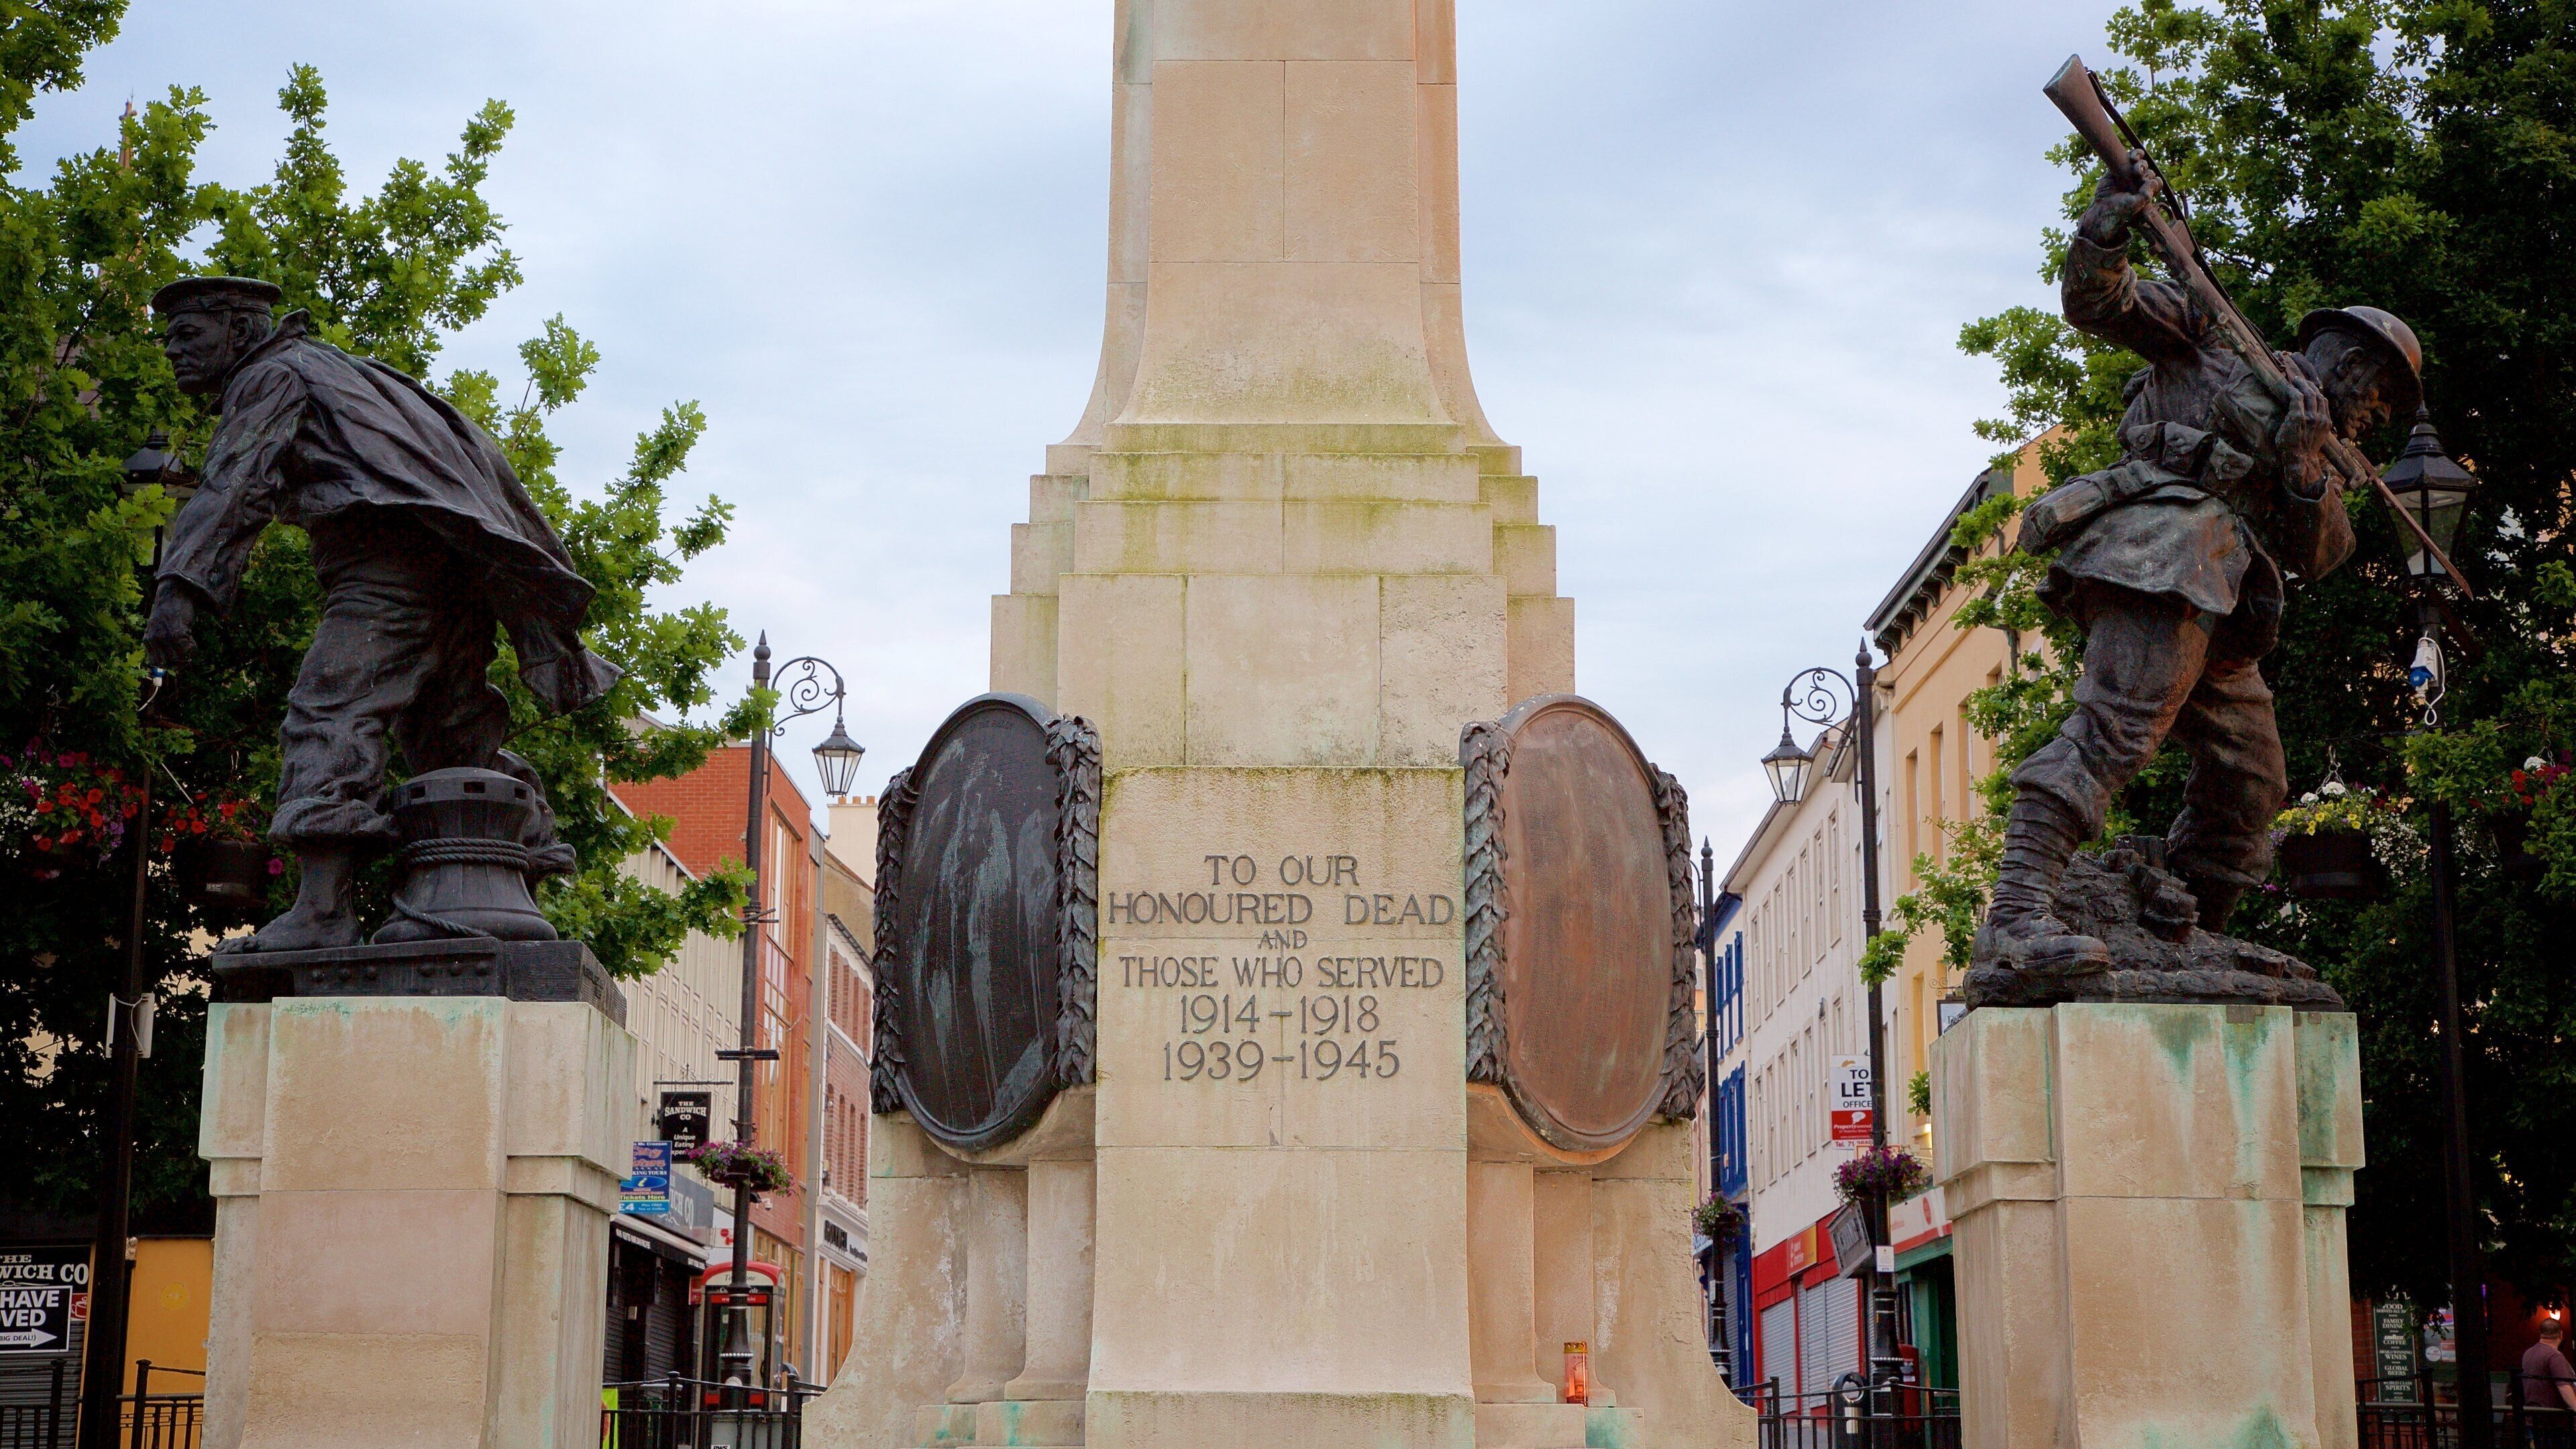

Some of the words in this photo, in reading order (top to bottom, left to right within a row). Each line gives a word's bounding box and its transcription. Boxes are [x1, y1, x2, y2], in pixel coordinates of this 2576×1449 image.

[1204, 855, 1256, 886] TO
[1279, 855, 1359, 886] OUR
[1108, 891, 1313, 924] HONOURED
[1344, 894, 1454, 924] DEAD
[1258, 929, 1307, 949] AND
[1119, 956, 1219, 987] THOSE
[1232, 957, 1303, 987] WHO
[1318, 957, 1444, 987] SERVED
[1849, 1069, 1869, 1079] TO
[664, 1107, 706, 1117] SANDWICH
[619, 1203, 635, 1211] £4
[60, 1263, 89, 1285] CO
[1, 1290, 60, 1308] HAVE
[0, 1309, 46, 1327] VED
